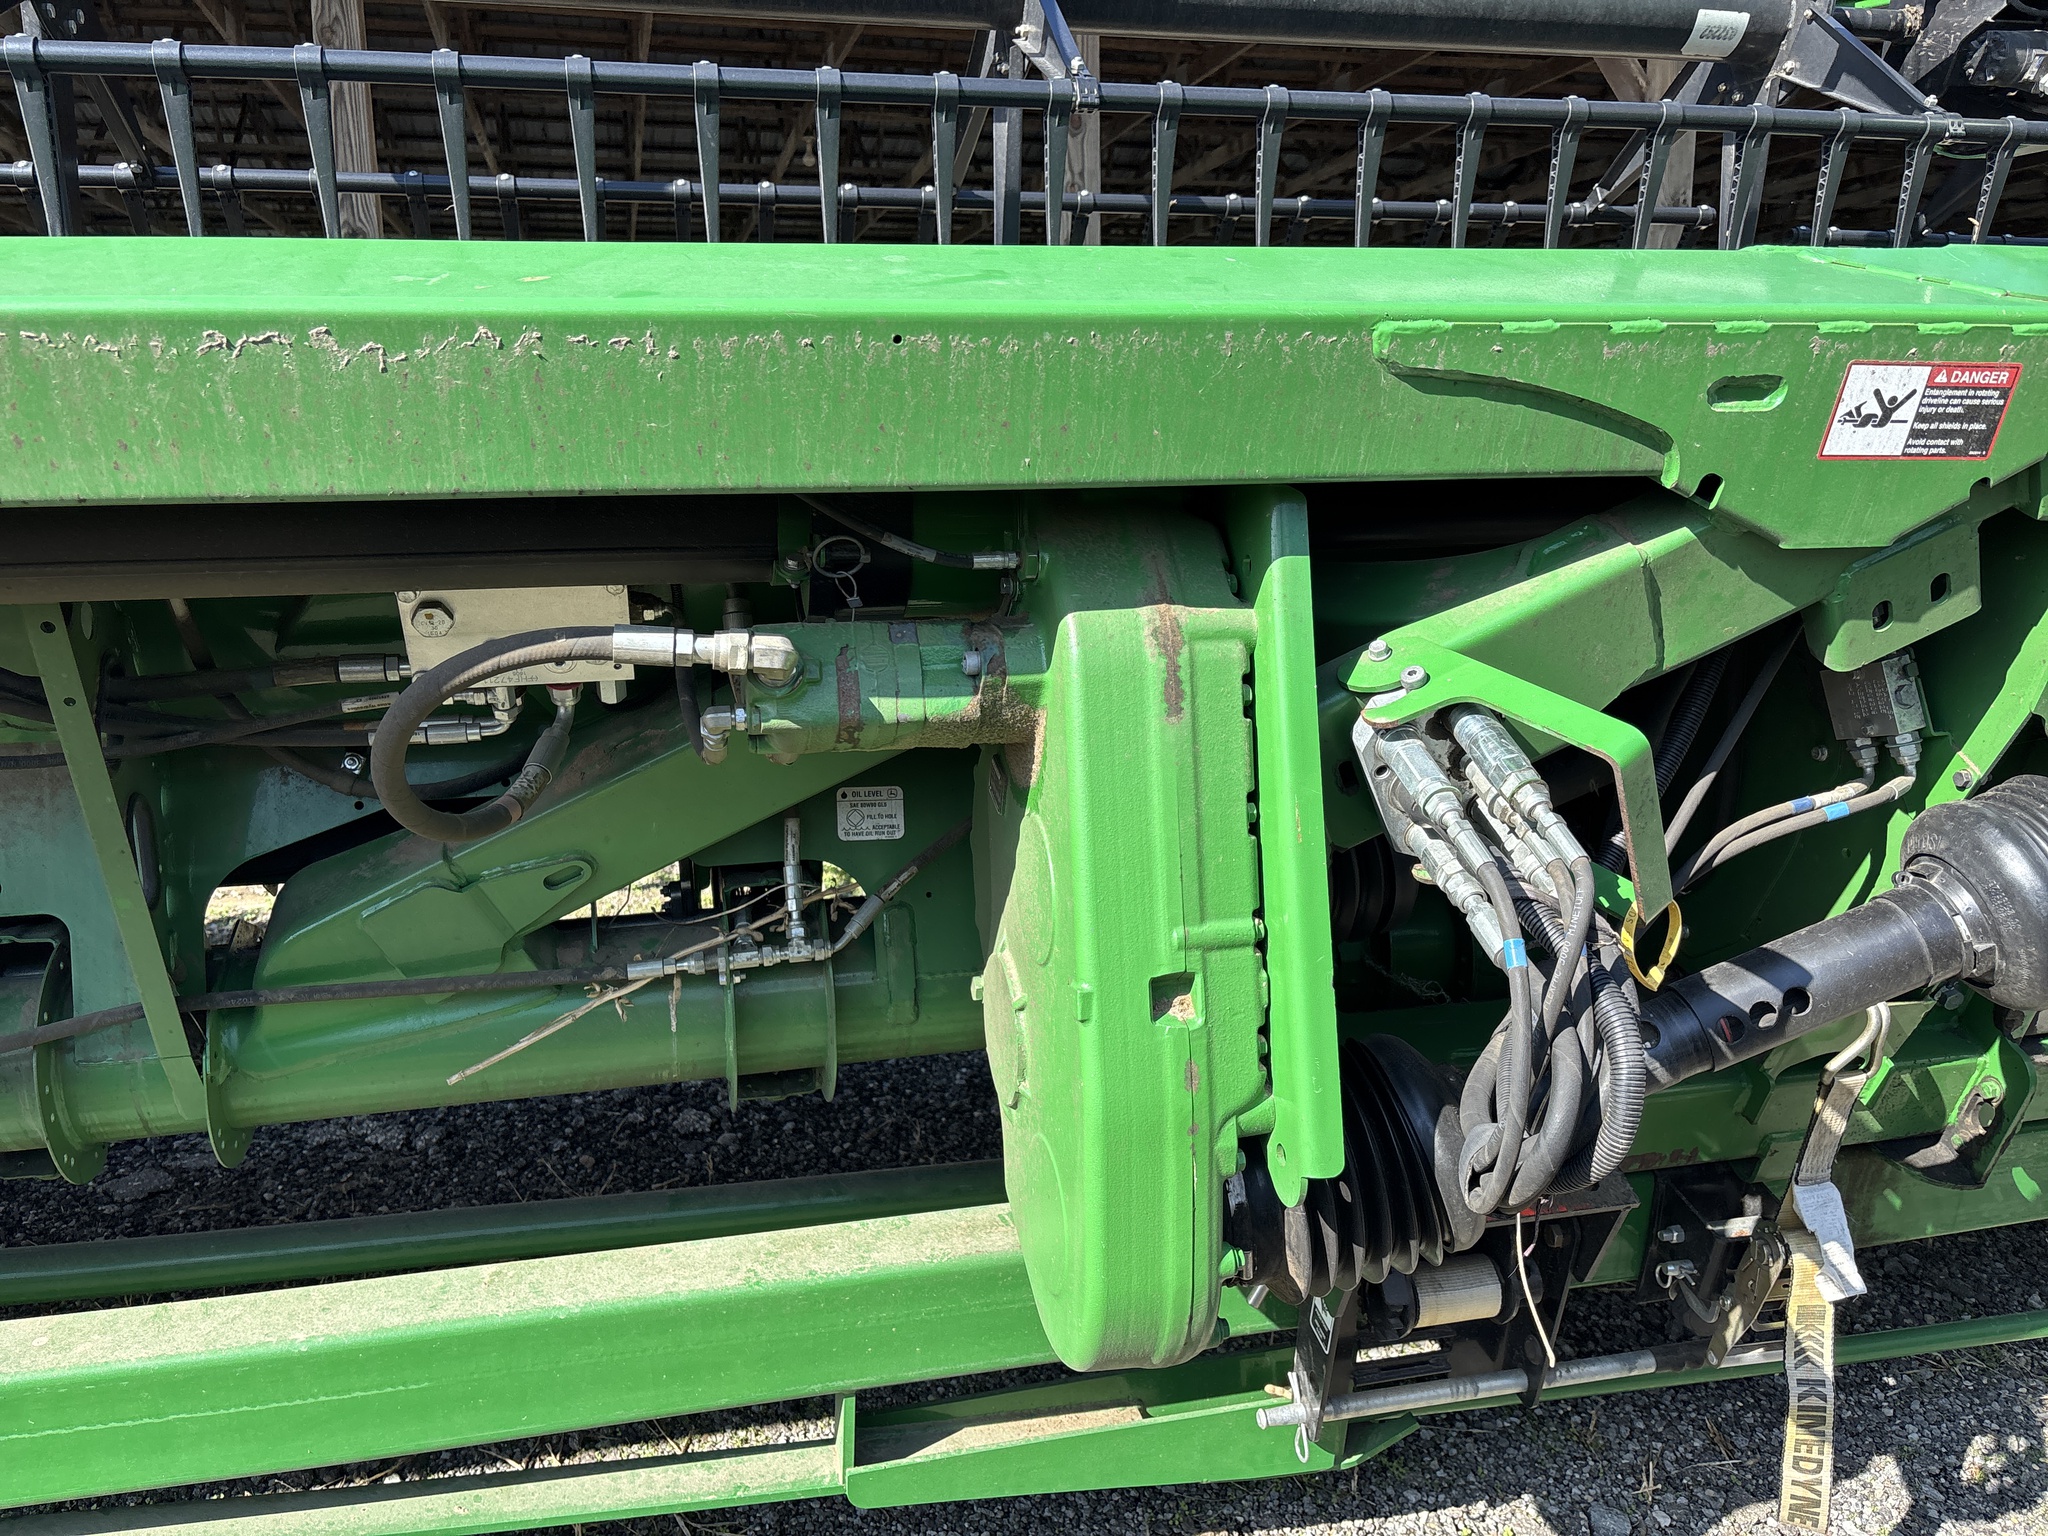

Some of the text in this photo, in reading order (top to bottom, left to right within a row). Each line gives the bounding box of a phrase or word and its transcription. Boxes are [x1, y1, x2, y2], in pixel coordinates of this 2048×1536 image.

[1950, 371, 2009, 384] DANGER
[1925, 388, 1968, 397] Entanglement
[1975, 389, 2000, 398] rotating
[1919, 405, 1937, 414] injury
[1913, 422, 1929, 430] Keep
[1939, 422, 1961, 430] shields
[1968, 423, 1987, 431] place.
[1904, 447, 1928, 455] rotating
[1568, 888, 1584, 936] MINETUFF
[1787, 1378, 1828, 1529] KINEDYNE
